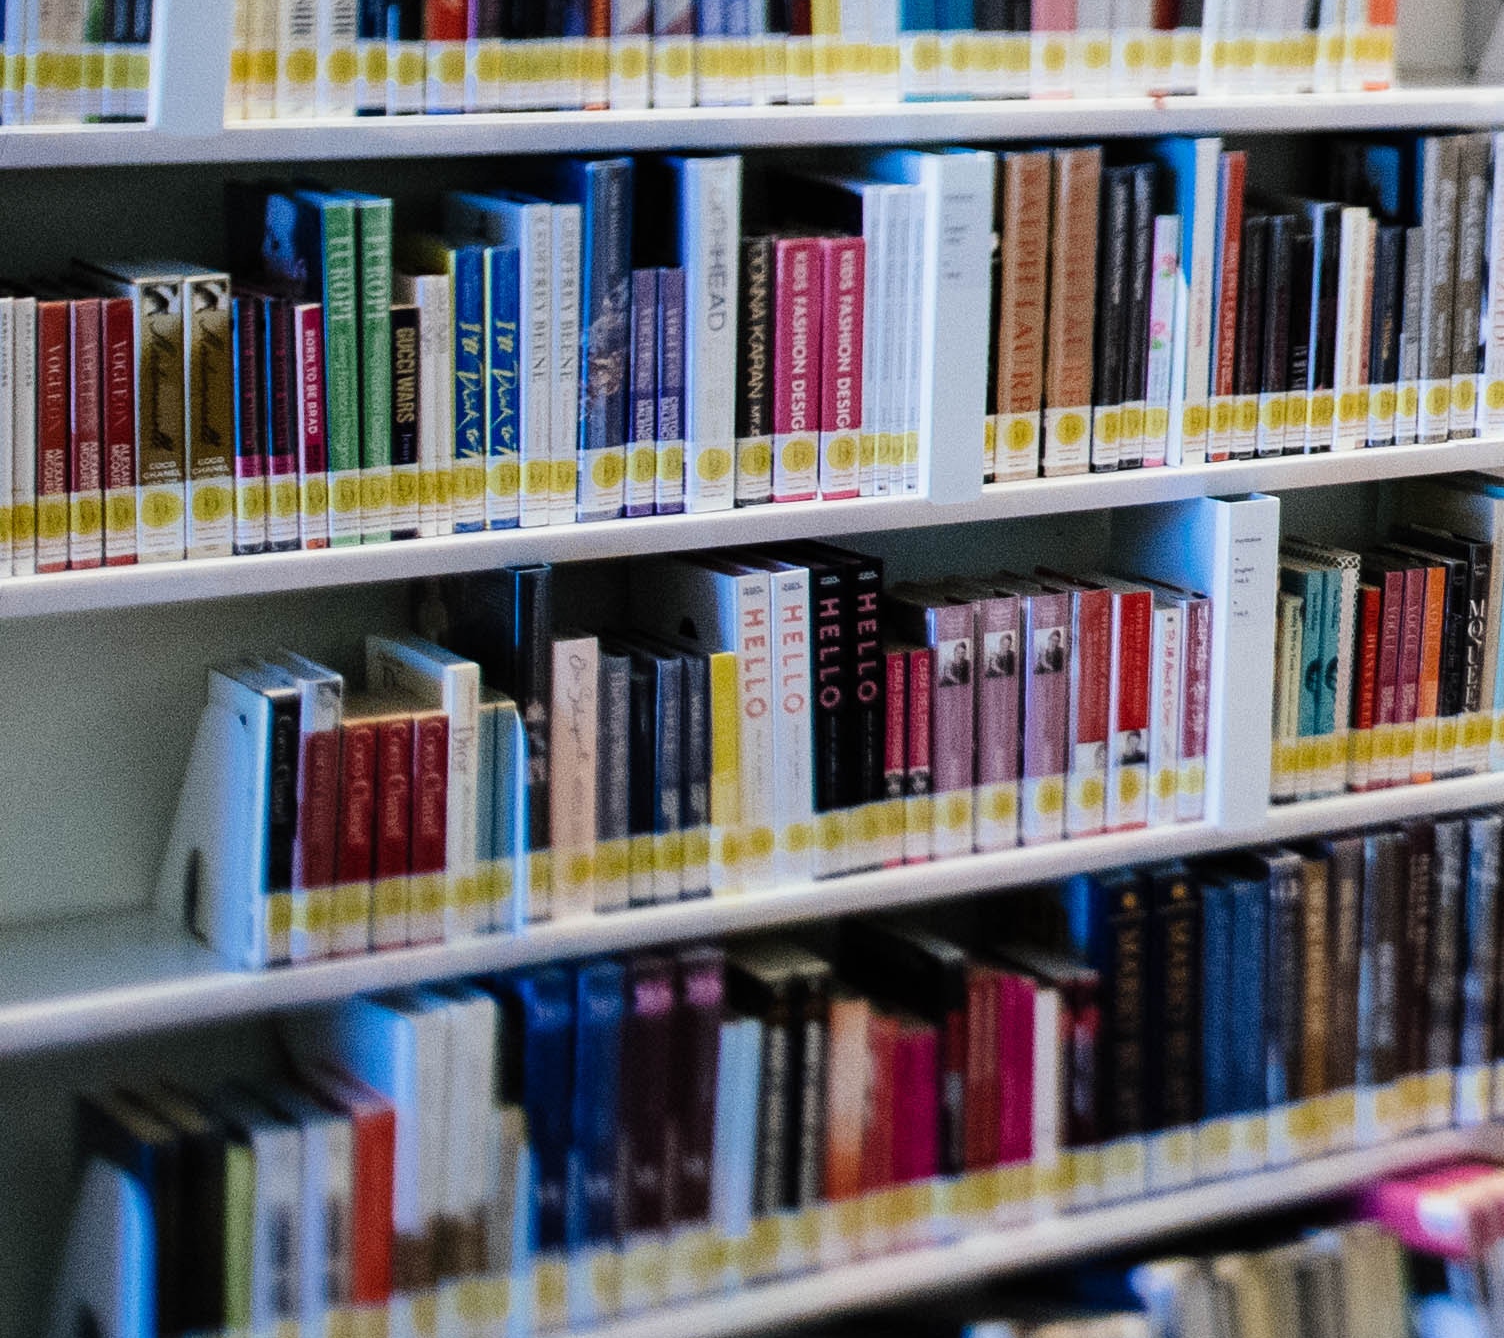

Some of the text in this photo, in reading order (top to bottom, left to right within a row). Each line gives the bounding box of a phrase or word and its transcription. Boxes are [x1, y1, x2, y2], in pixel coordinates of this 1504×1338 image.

[792, 250, 808, 292] KIDS
[839, 249, 855, 292] KIDS
[747, 242, 769, 399] DONNA KARAN
[791, 296, 807, 375] FASHION
[836, 295, 853, 373] FASHION
[46, 345, 61, 406] VOGUE
[111, 341, 127, 400] VOGUE
[304, 328, 318, 435] BORN TO BE BRAD
[394, 326, 416, 424] GUCCI WARS
[743, 608, 768, 719] HELLO
[782, 604, 805, 715] HELLO
[818, 597, 840, 709] HELLO
[857, 592, 878, 702] HELLO
[349, 780, 374, 846] Chanel
[386, 774, 411, 841] Chanel
[419, 774, 443, 836] Chanel
